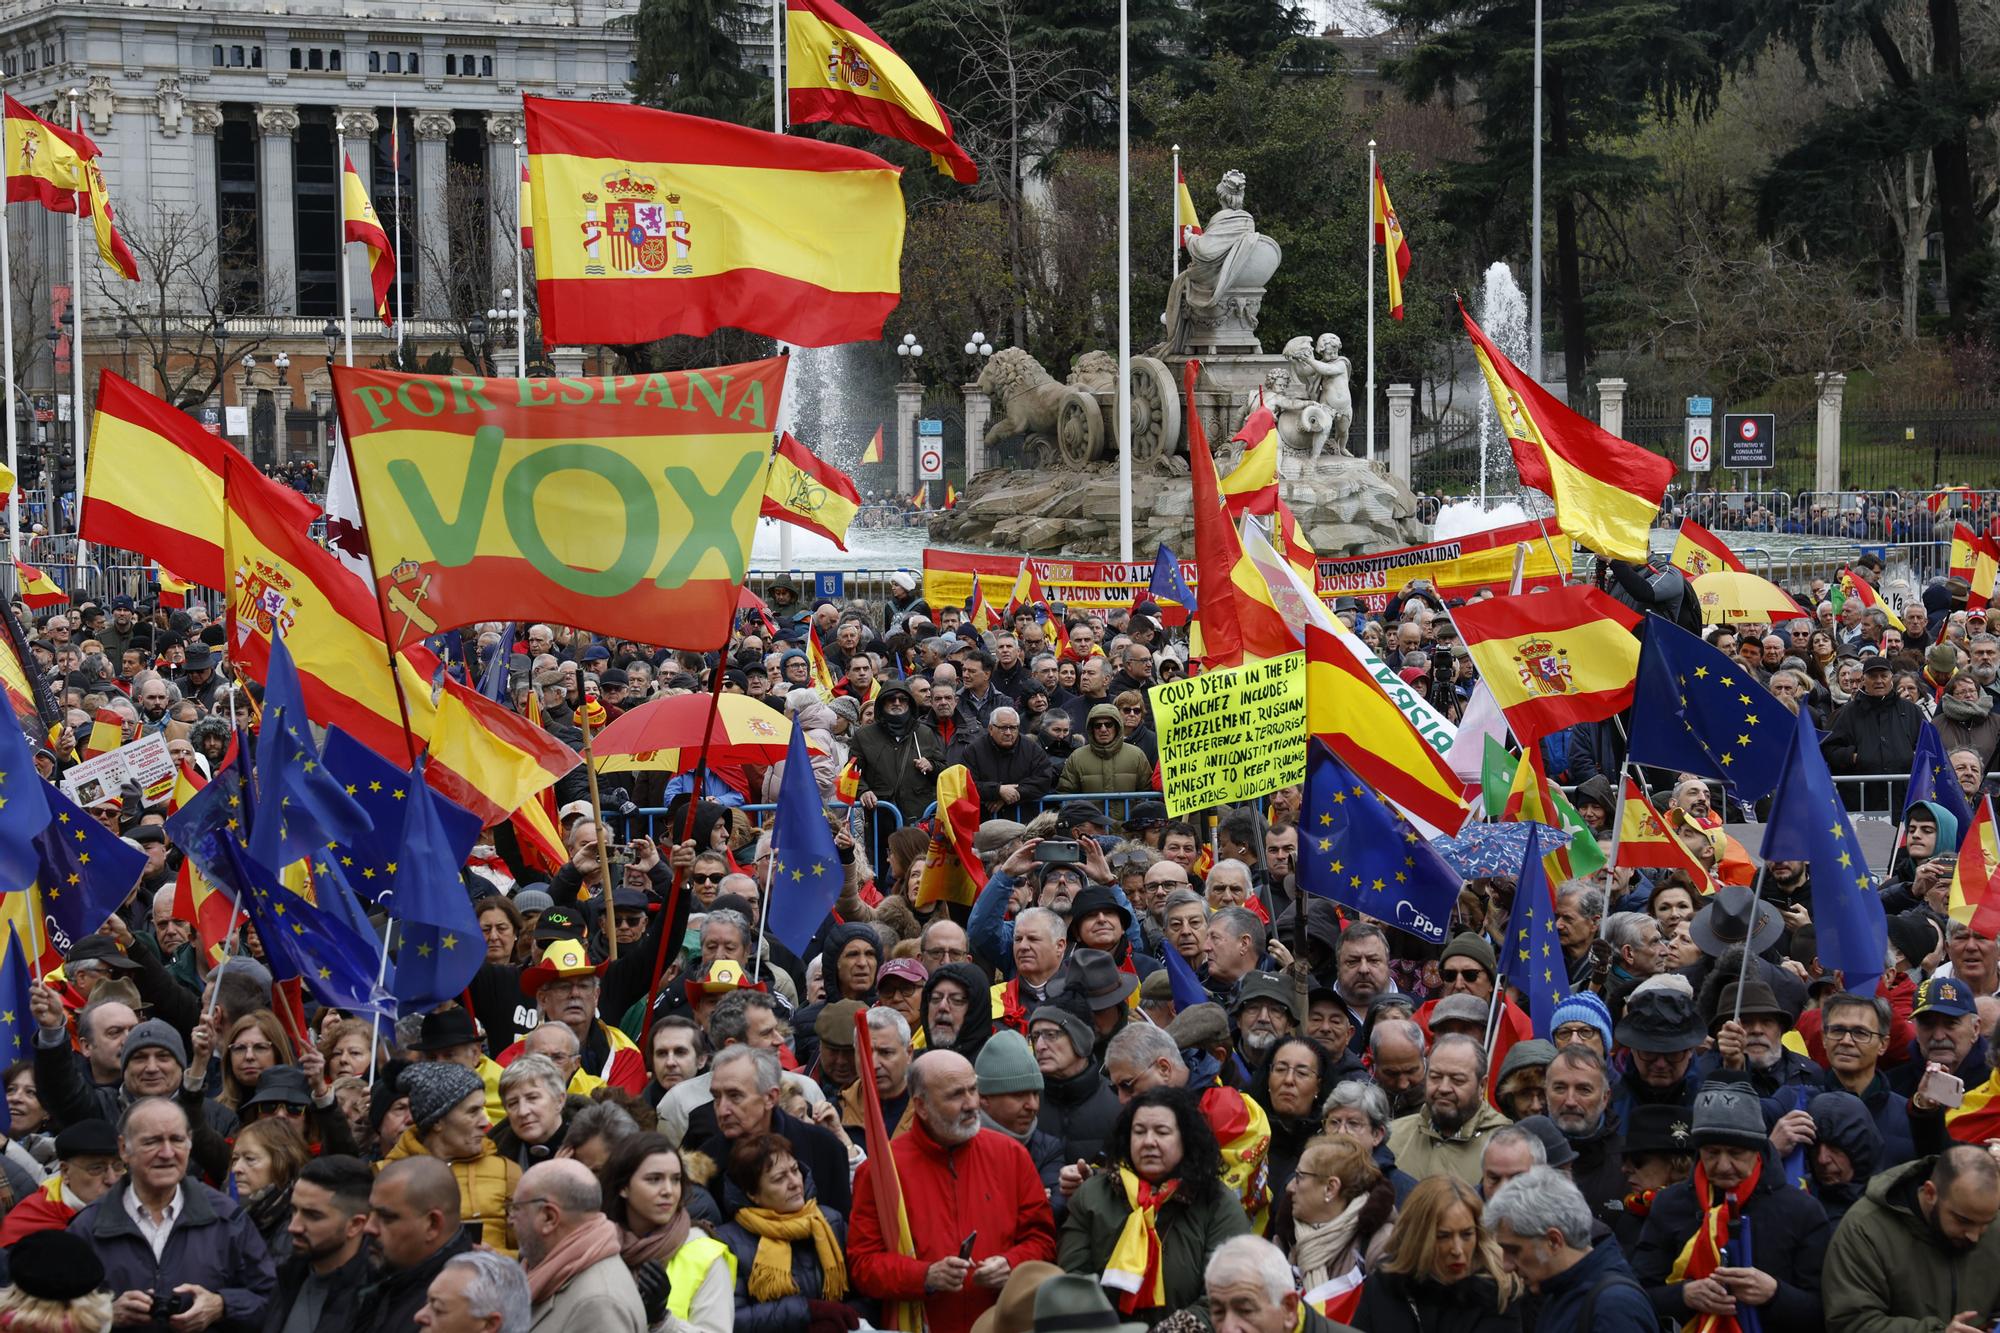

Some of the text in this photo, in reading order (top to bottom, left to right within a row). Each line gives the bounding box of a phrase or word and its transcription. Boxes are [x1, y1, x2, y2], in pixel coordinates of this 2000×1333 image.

[352, 376, 497, 429] POR
[387, 425, 765, 597] VOX
[1102, 566, 1126, 582] NO
[1060, 587, 1100, 601] PACTOS
[1104, 587, 1129, 601] CON
[1159, 682, 1195, 705] COUP
[1245, 671, 1260, 685] IN
[1264, 663, 1283, 679] THE
[1240, 680, 1288, 706] INCLUDES
[1166, 697, 1303, 745] EMBEZZLEMENT, RUSSIAN
[1163, 733, 1242, 763] INTERFERENCE
[1167, 765, 1177, 780] IN
[1180, 760, 1197, 775] HIS
[1168, 772, 1216, 799] AMNESTY
[1222, 767, 1238, 783] TO
[1243, 760, 1270, 779] KEEP
[1172, 787, 1228, 812] THREATENS
[1235, 778, 1277, 798] JUDICIAL
[548, 913, 568, 923] VOX
[1413, 915, 1443, 936] ppe
[53, 931, 74, 951] pp
